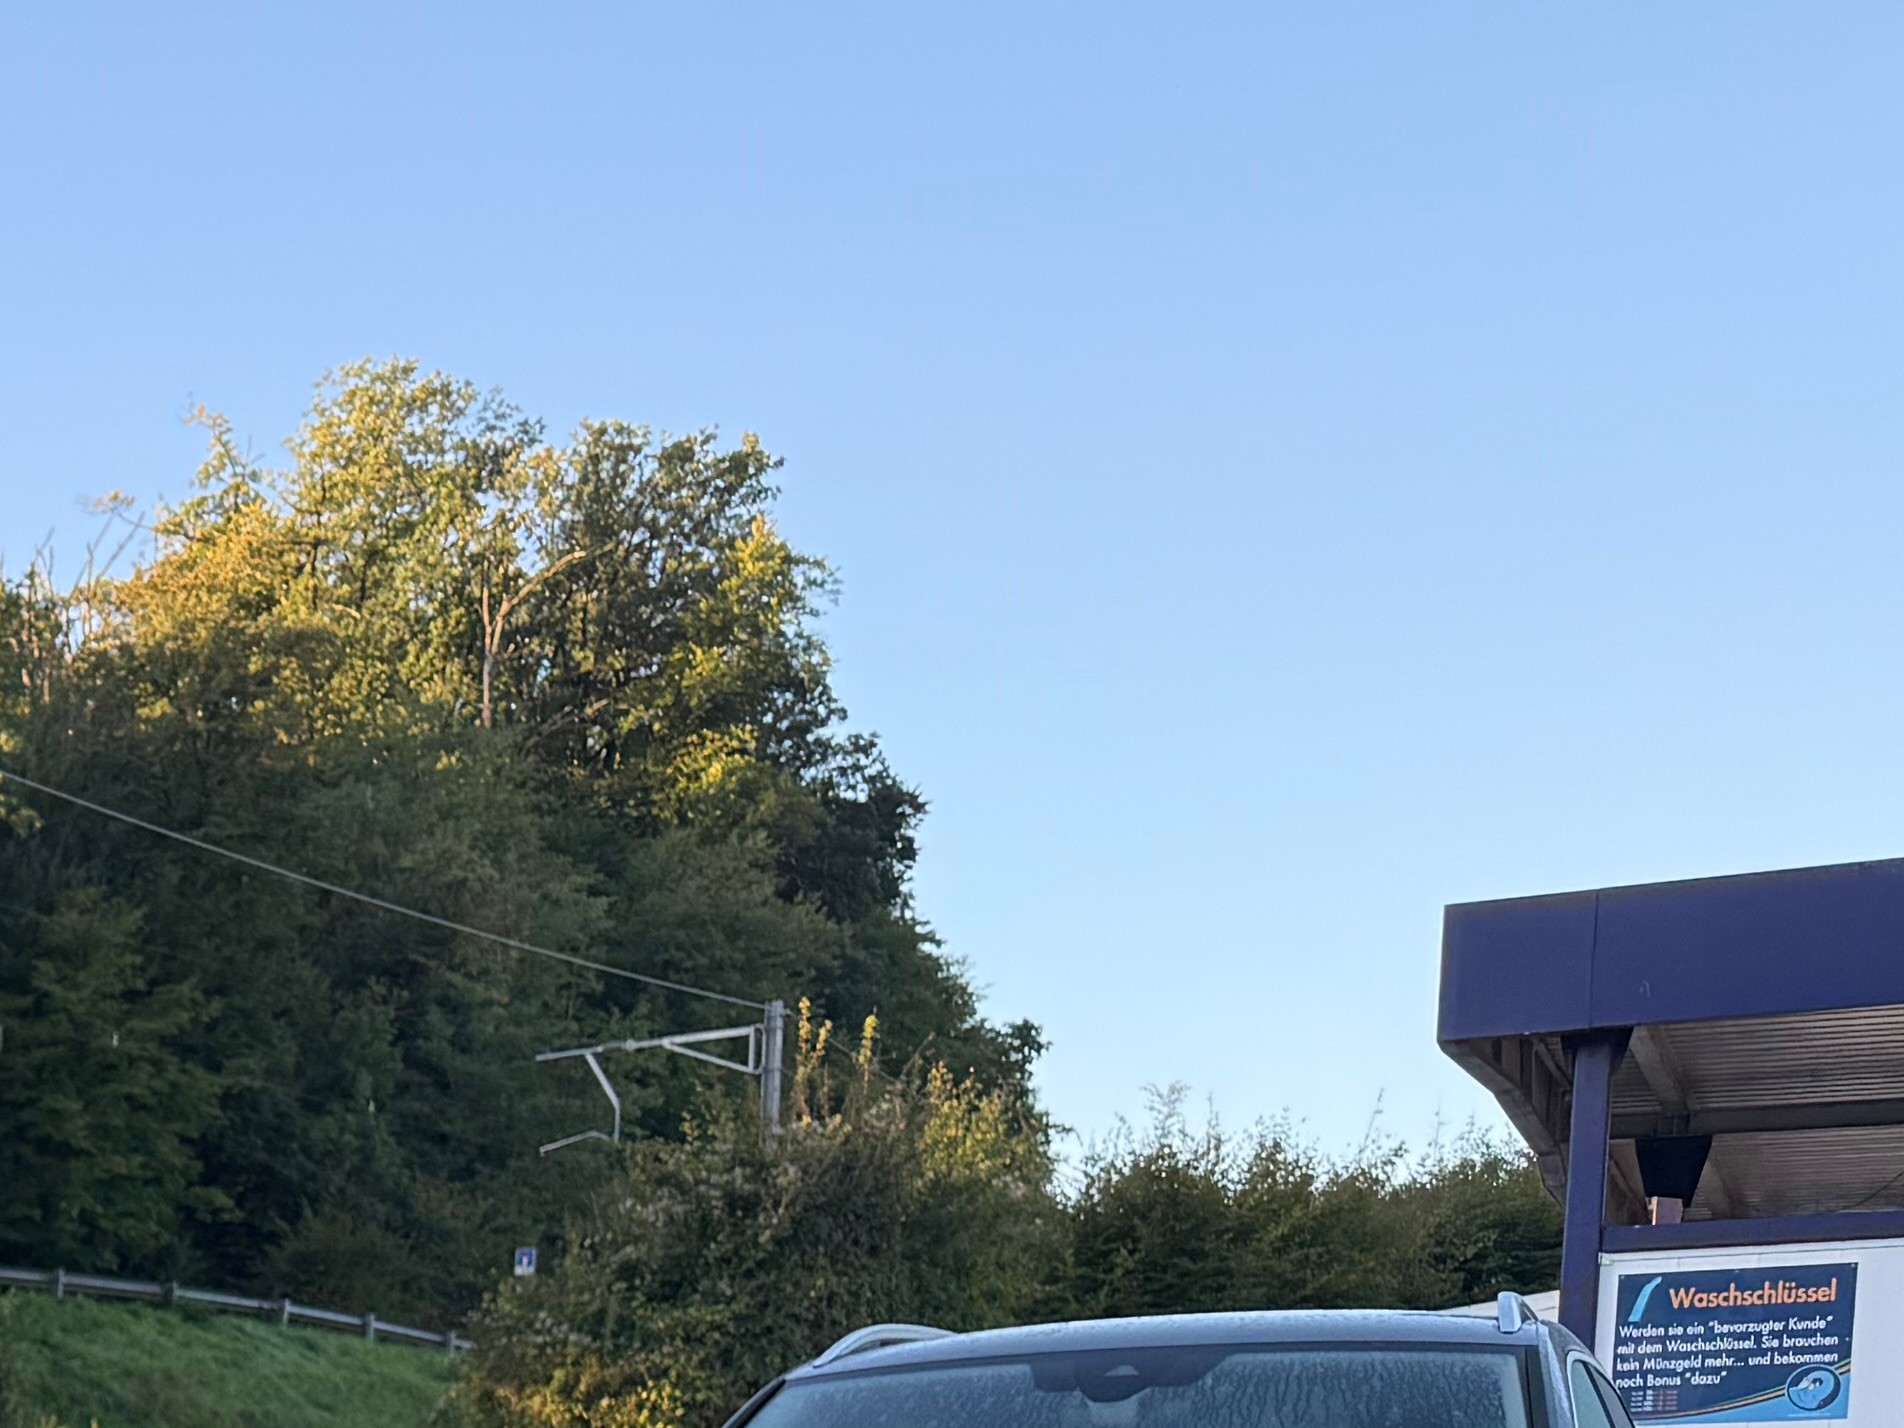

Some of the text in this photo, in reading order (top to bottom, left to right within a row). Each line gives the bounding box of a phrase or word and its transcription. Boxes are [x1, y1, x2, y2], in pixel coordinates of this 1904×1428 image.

[1669, 1277, 1837, 1309] Waschschlüssel
[1619, 1323, 1664, 1338] Werden
[1668, 1323, 1684, 1336] sie
[1638, 1340, 1662, 1354] dem
[1761, 1336, 1779, 1348] Sie
[1783, 1332, 1838, 1347] brauchen
[1617, 1358, 1639, 1371] kein
[1643, 1354, 1701, 1372] Münzgeld
[1748, 1352, 1770, 1366] und
[1774, 1351, 1838, 1365] bekommen
[1616, 1373, 1643, 1388] noch
[1647, 1374, 1681, 1386] Bonus
